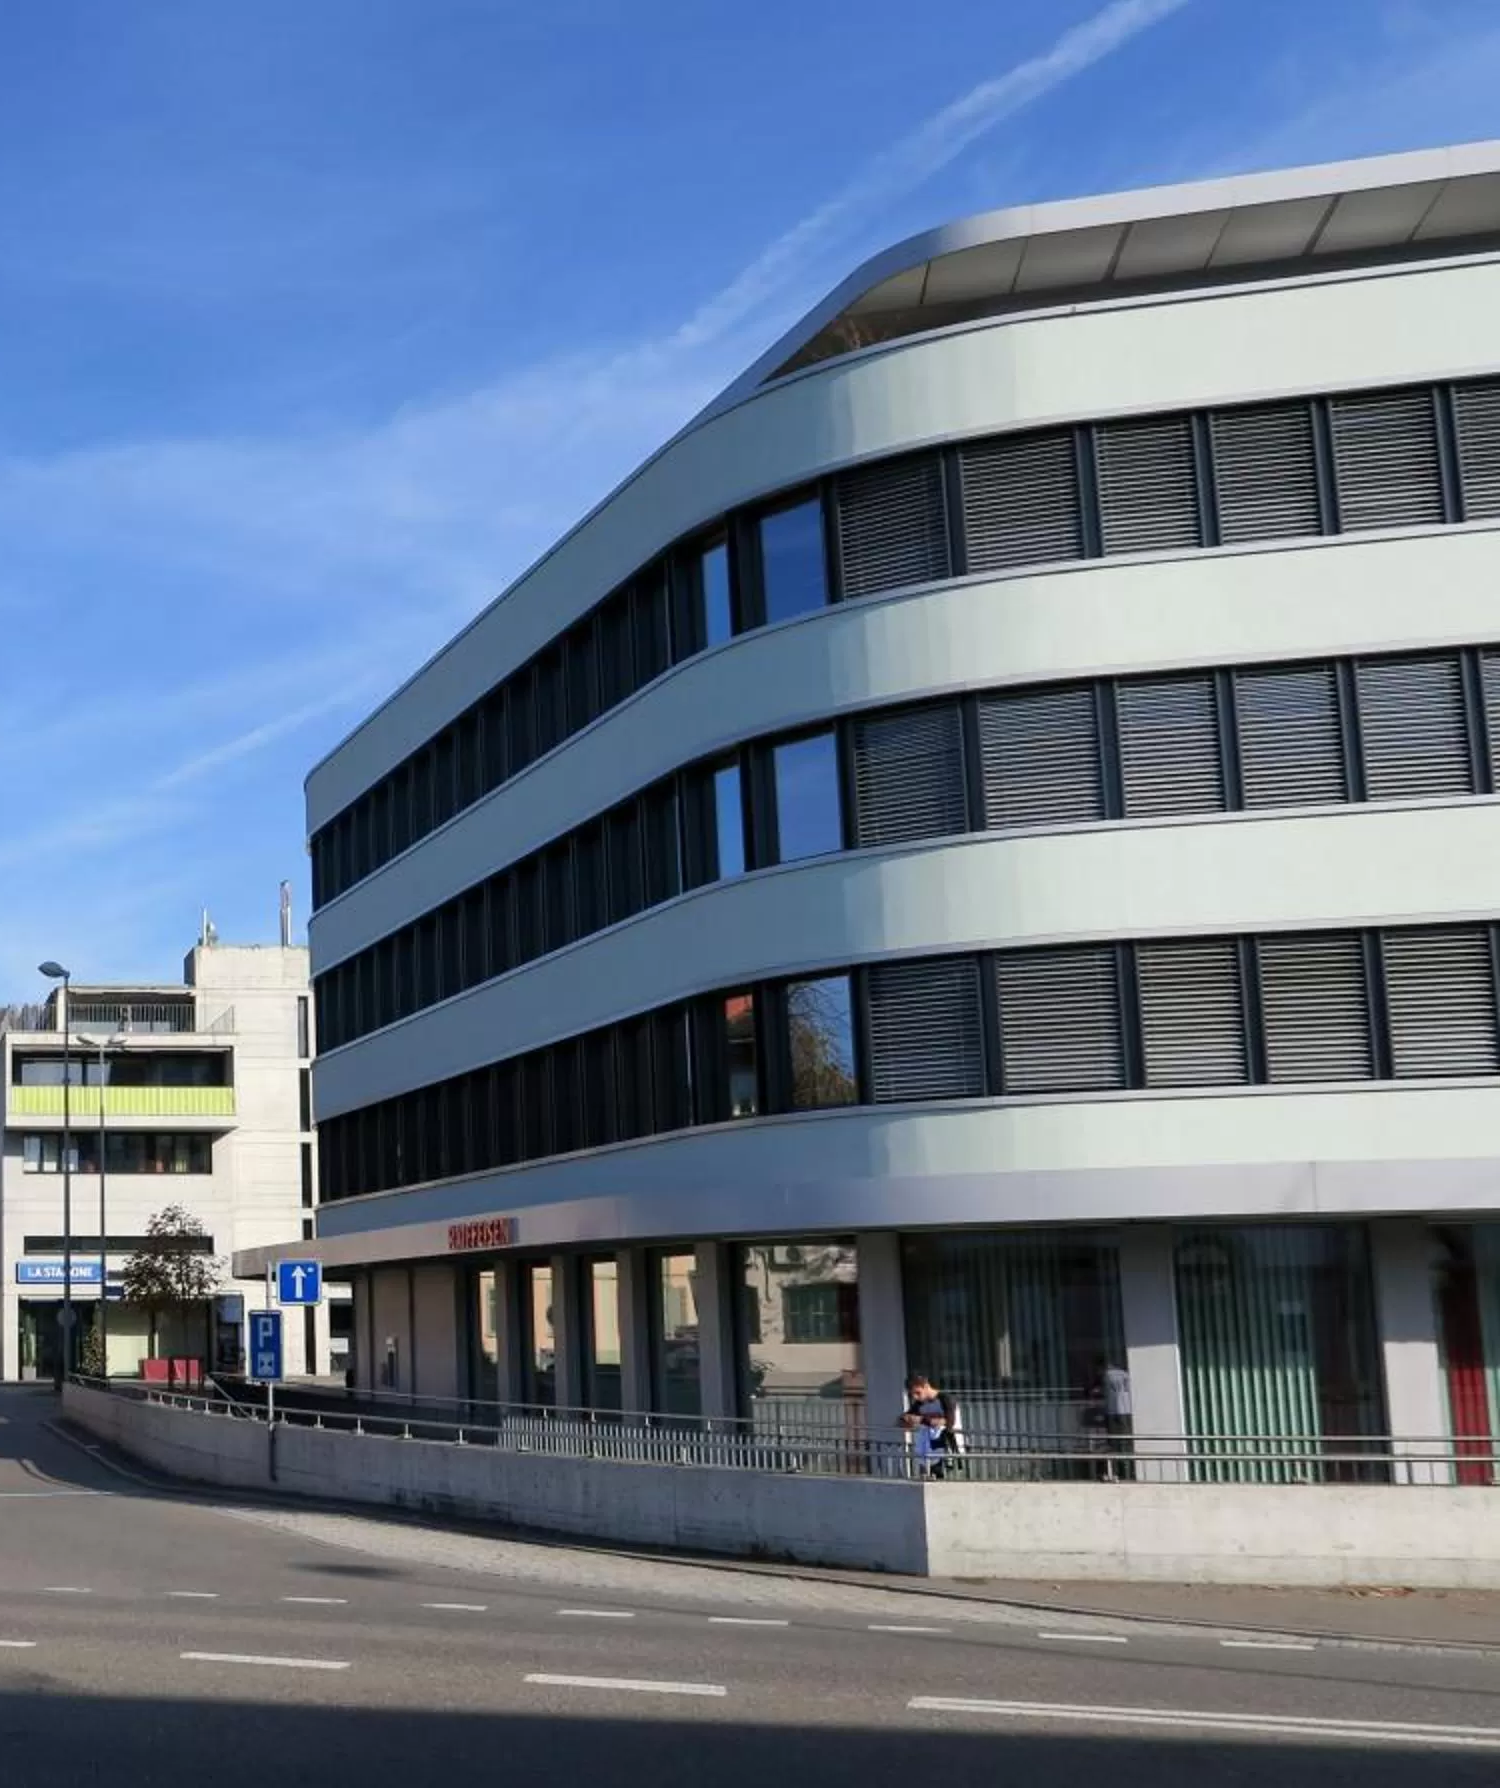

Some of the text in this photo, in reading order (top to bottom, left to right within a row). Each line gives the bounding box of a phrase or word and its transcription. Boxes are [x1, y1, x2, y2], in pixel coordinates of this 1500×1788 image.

[27, 1267, 94, 1278] LA STAONE
[257, 1317, 273, 1349] P
